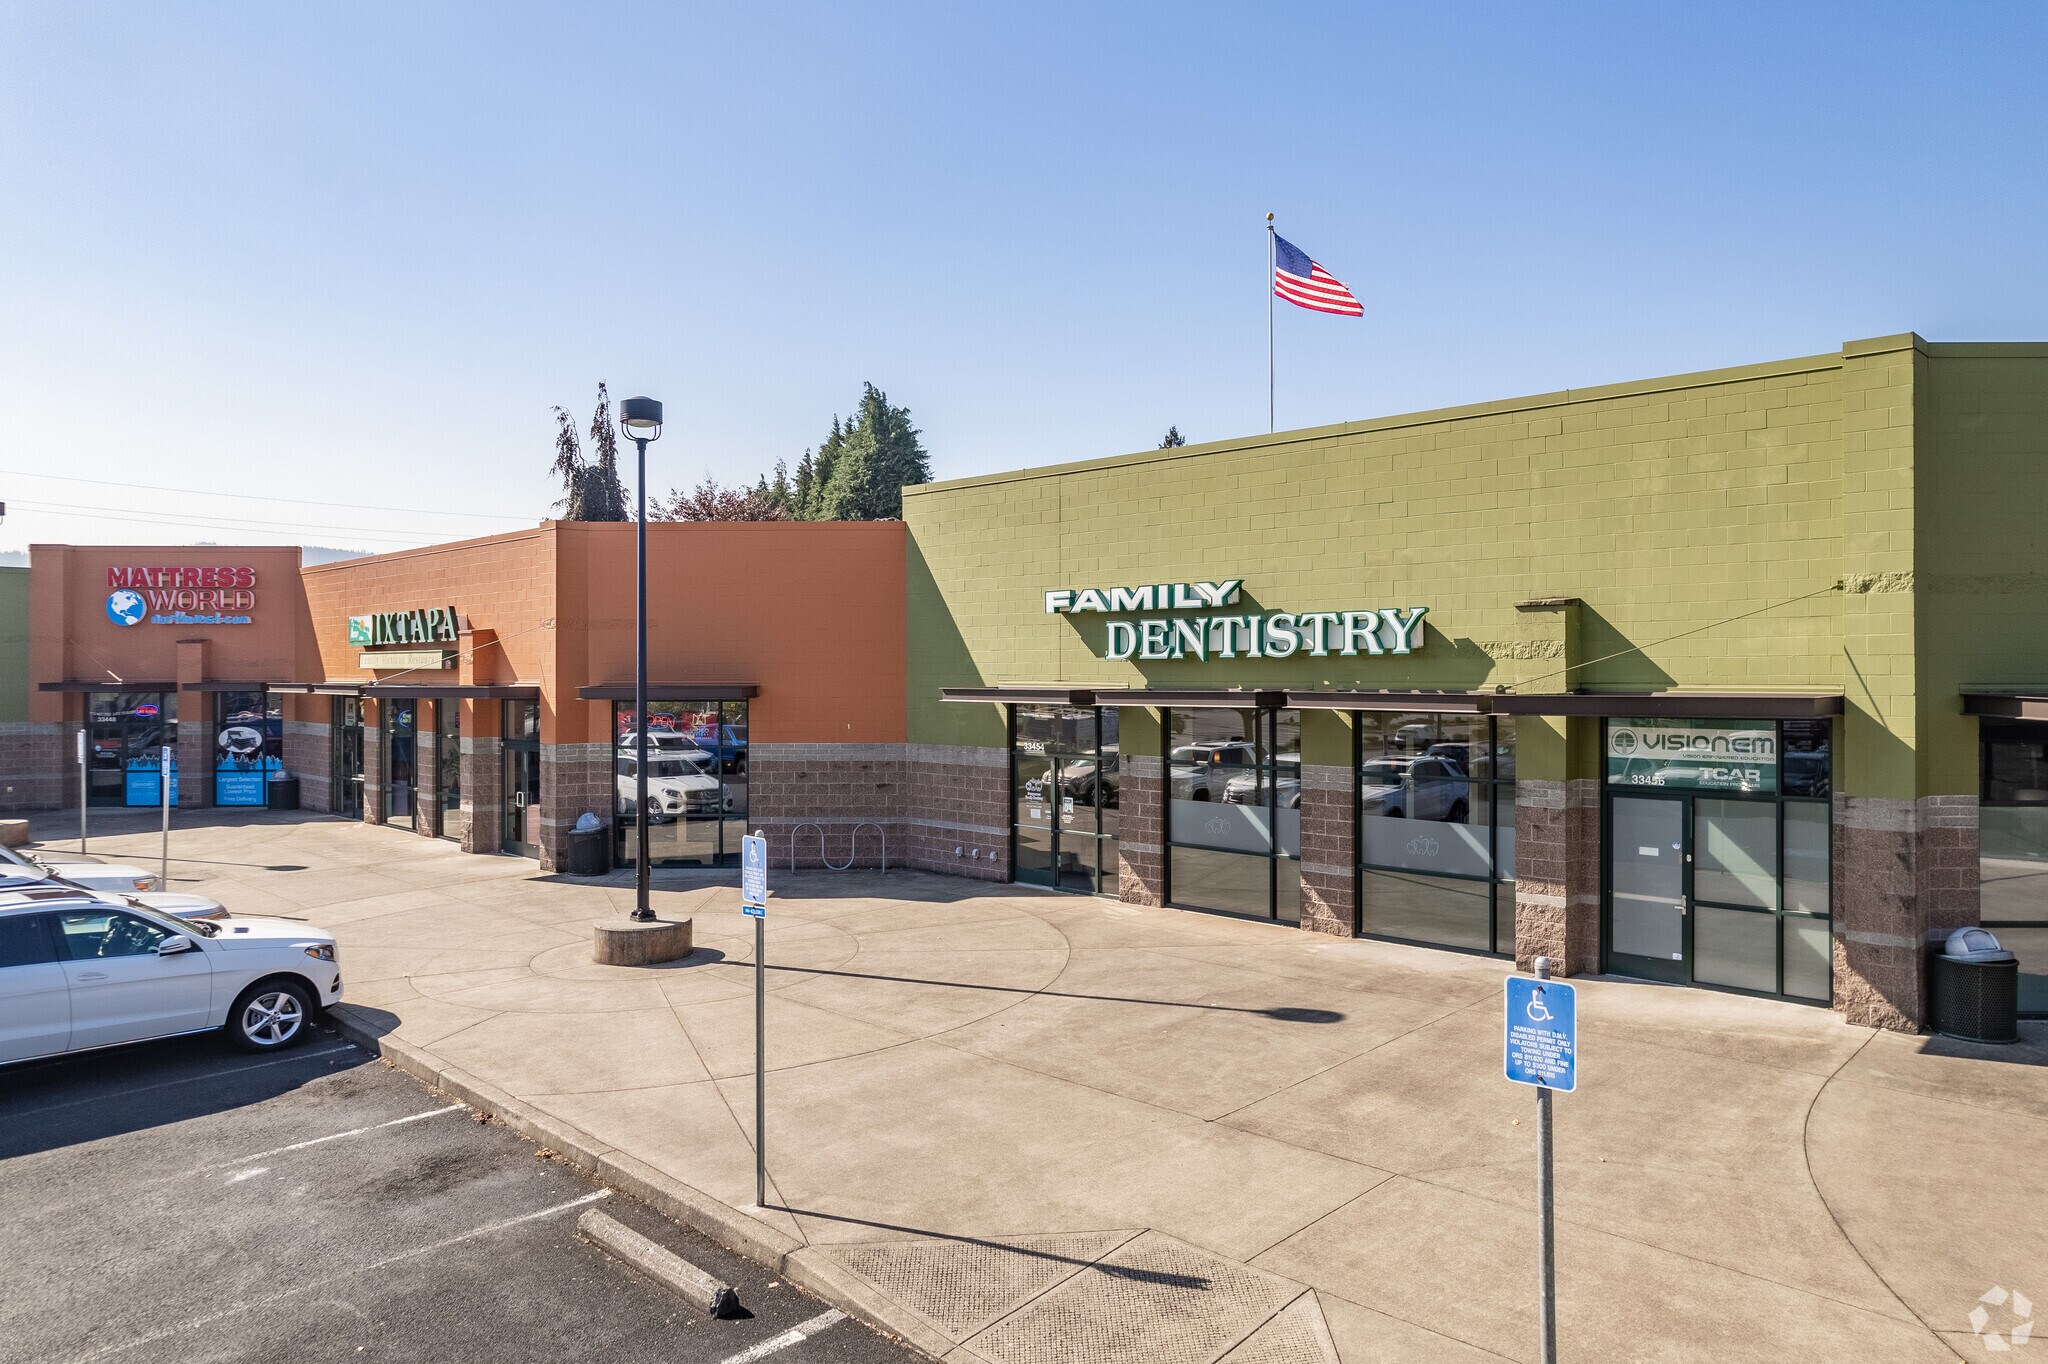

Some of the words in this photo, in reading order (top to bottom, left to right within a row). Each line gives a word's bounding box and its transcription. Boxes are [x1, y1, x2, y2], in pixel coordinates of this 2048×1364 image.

[107, 567, 255, 588] MATTRESS
[146, 589, 255, 611] WORLD
[1044, 579, 1244, 614] FAMILY
[373, 606, 458, 645] IXTAPA
[1105, 607, 1429, 662] DENTISTRY
[646, 714, 676, 728] OPEN
[1023, 742, 1045, 751] 33454
[1631, 774, 1665, 786] 33456
[1699, 767, 1761, 782] TCAR
[1511, 1032, 1535, 1040] DISABLED
[1514, 1026, 1536, 1034] PARKING
[1510, 1038, 1538, 1048] VIOLATORS
[1539, 1043, 1563, 1052] SUBJECT
[1521, 1047, 1541, 1055] TOWING
[1543, 1051, 1560, 1059] UNDER
[1548, 1065, 1565, 1073] UNDER
